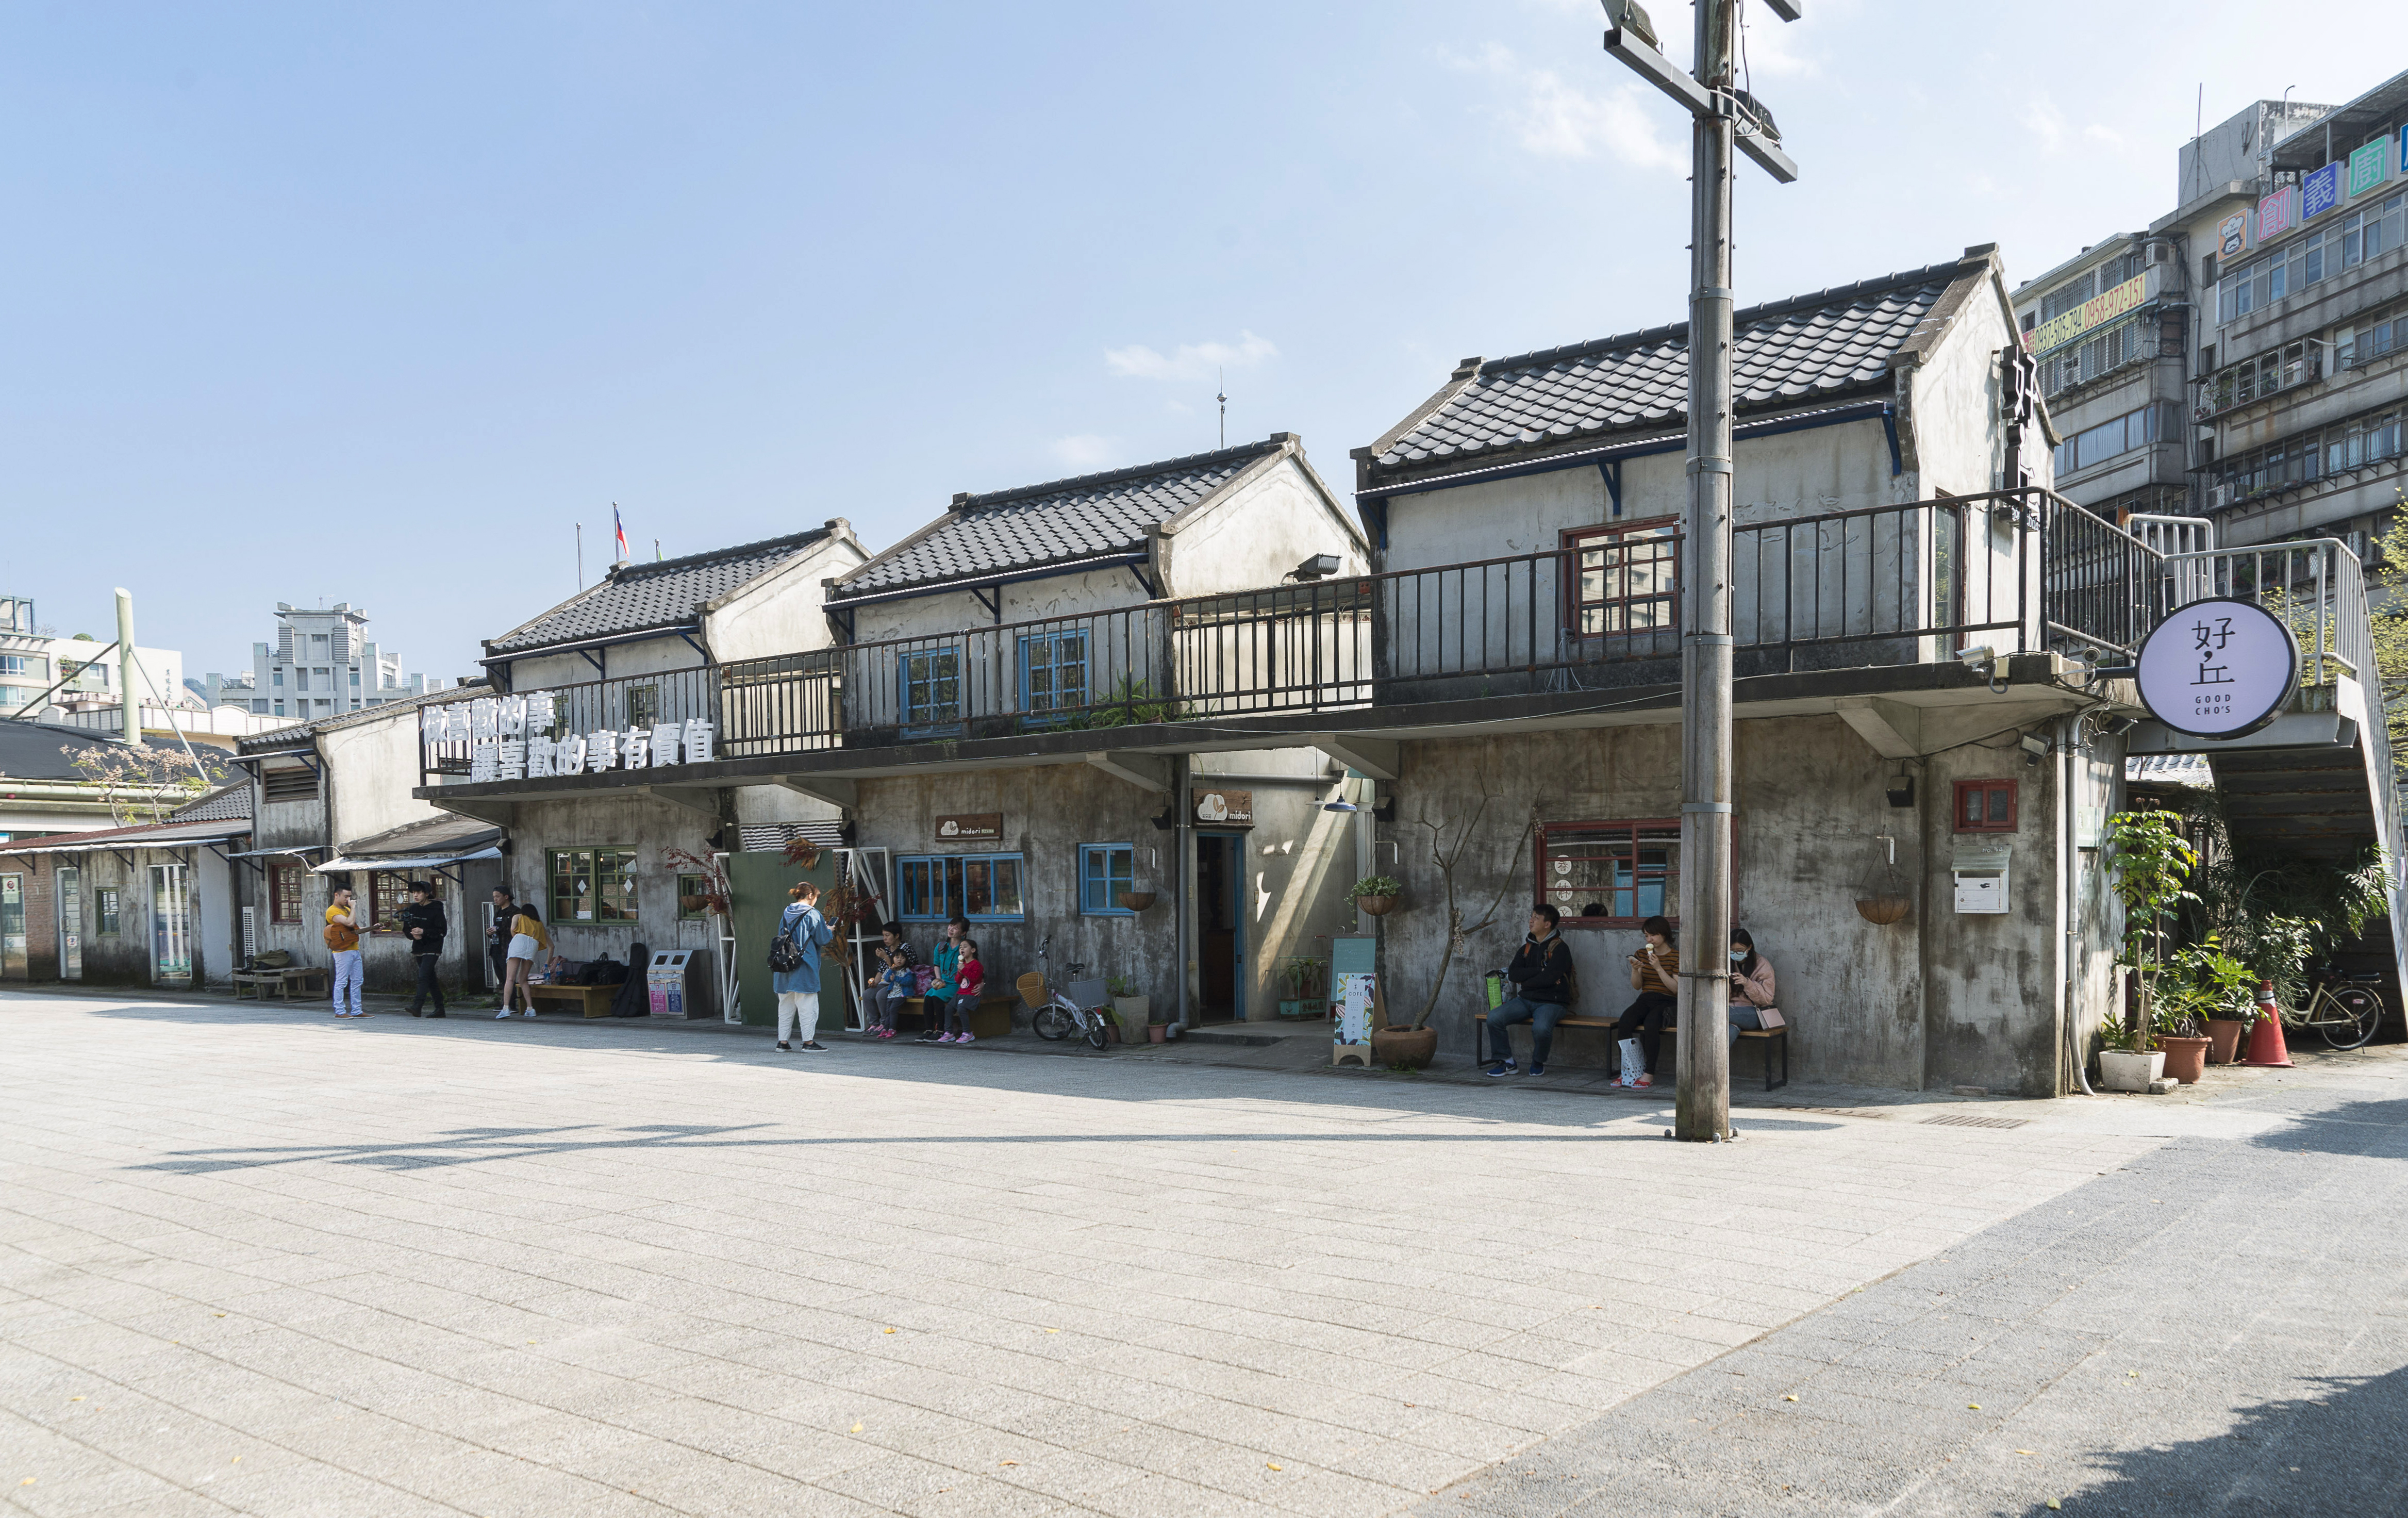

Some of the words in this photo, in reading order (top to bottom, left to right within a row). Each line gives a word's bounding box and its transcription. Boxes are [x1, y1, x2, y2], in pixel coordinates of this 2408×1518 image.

[2260, 129, 2408, 238] 創義廚
[2085, 275, 2144, 329] 0958-972-151
[421, 690, 556, 745] 做喜歡的事
[2196, 694, 2231, 704] GOOD
[2196, 705, 2231, 715] CHO'S
[470, 718, 715, 783] 讓喜歡的事有價值
[1229, 810, 1251, 820] midori
